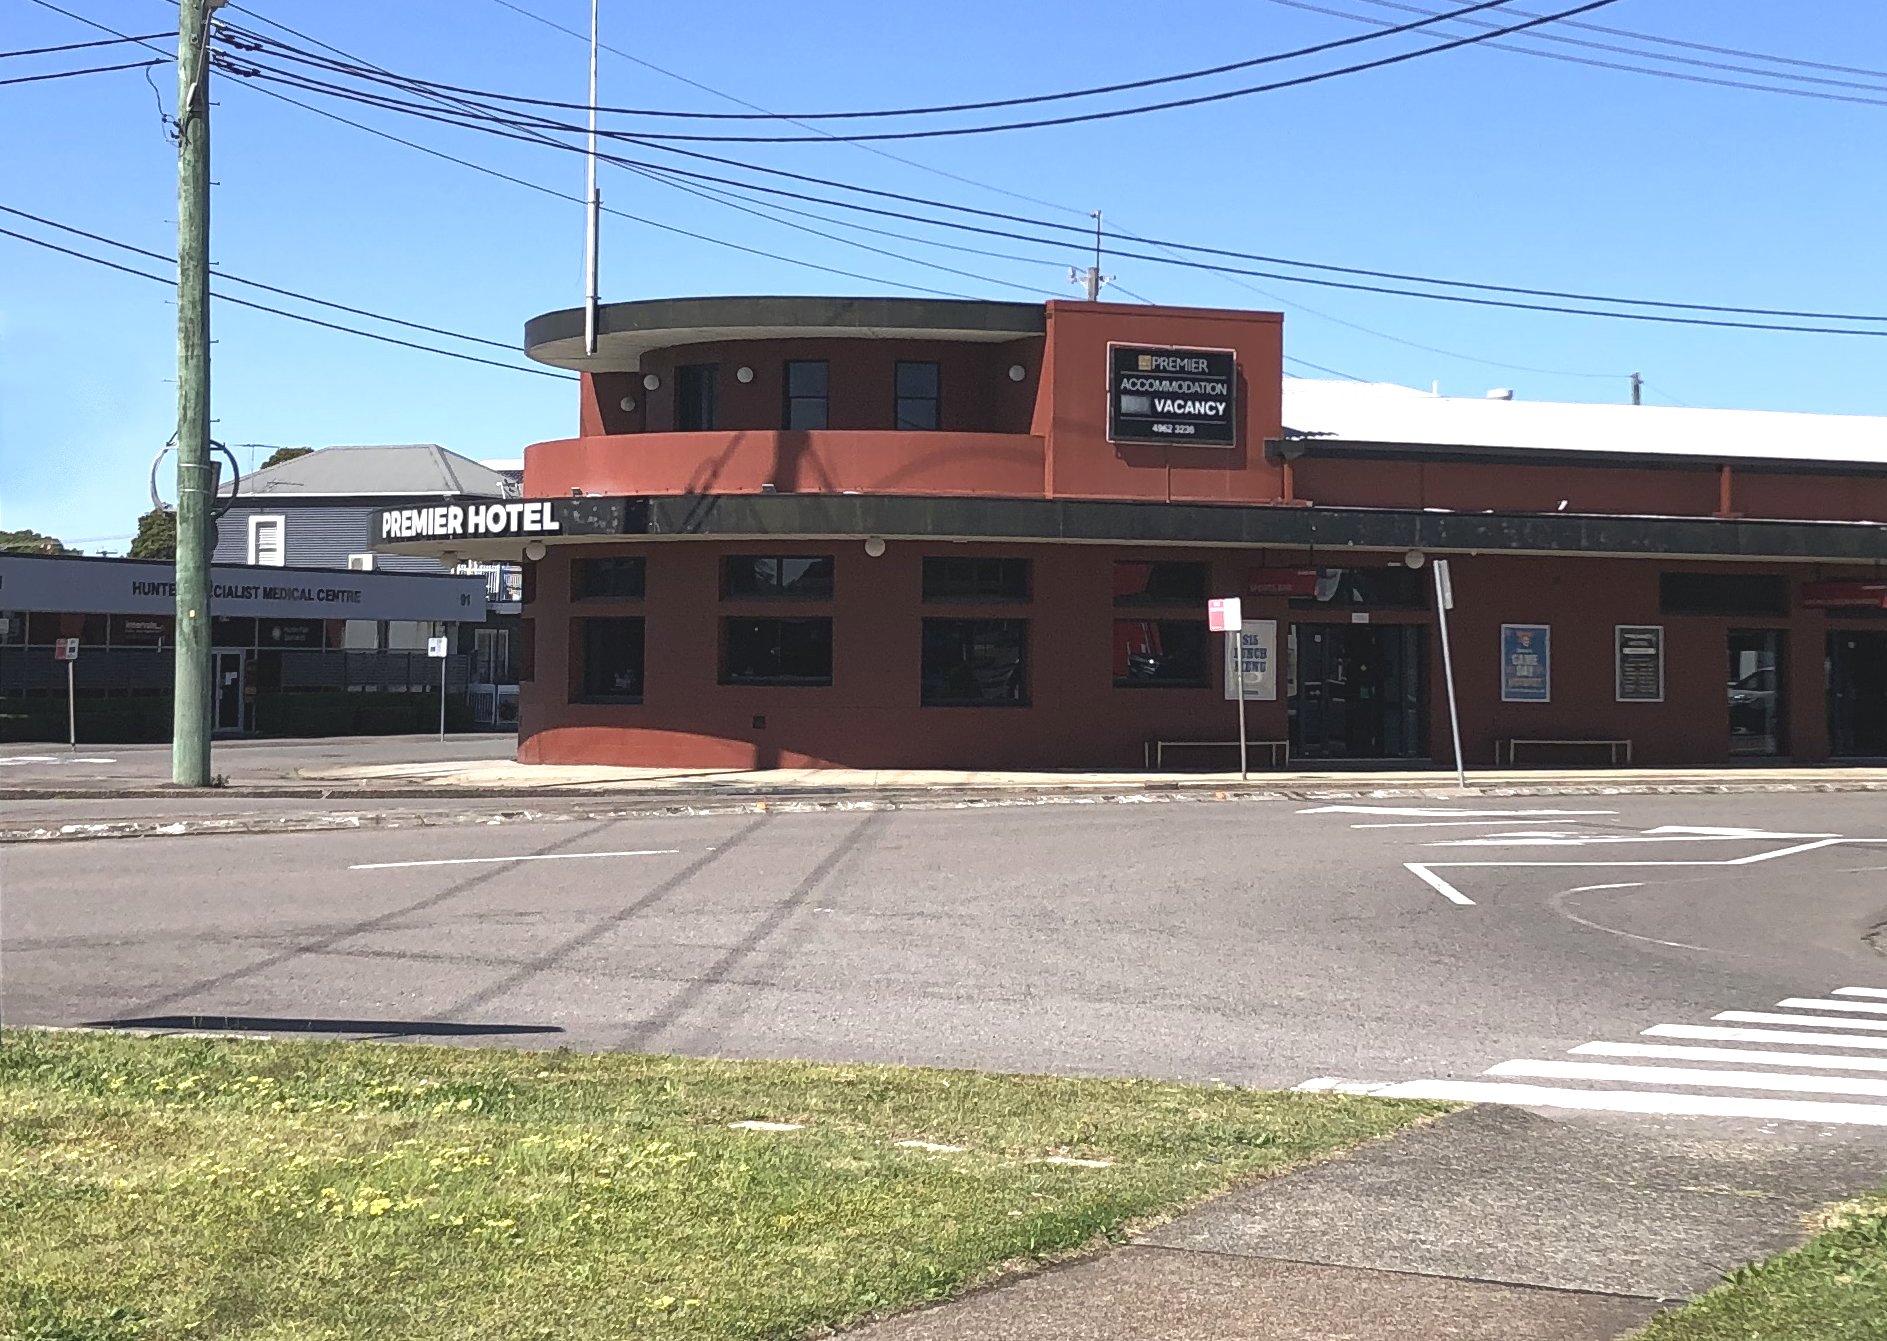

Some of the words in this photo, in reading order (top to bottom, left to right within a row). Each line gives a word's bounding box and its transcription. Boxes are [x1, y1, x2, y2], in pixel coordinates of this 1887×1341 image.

[1151, 356, 1208, 372] PREMIER
[1120, 378, 1227, 395] ACCOMMODATION
[1154, 398, 1226, 416] VACANCY
[382, 506, 463, 538] PREMIER
[468, 502, 559, 533] HOTEL
[132, 581, 176, 597] HUNTE
[209, 583, 260, 600] CIALIST
[262, 586, 315, 601] MEDICAL
[317, 588, 361, 603] CENTRE
